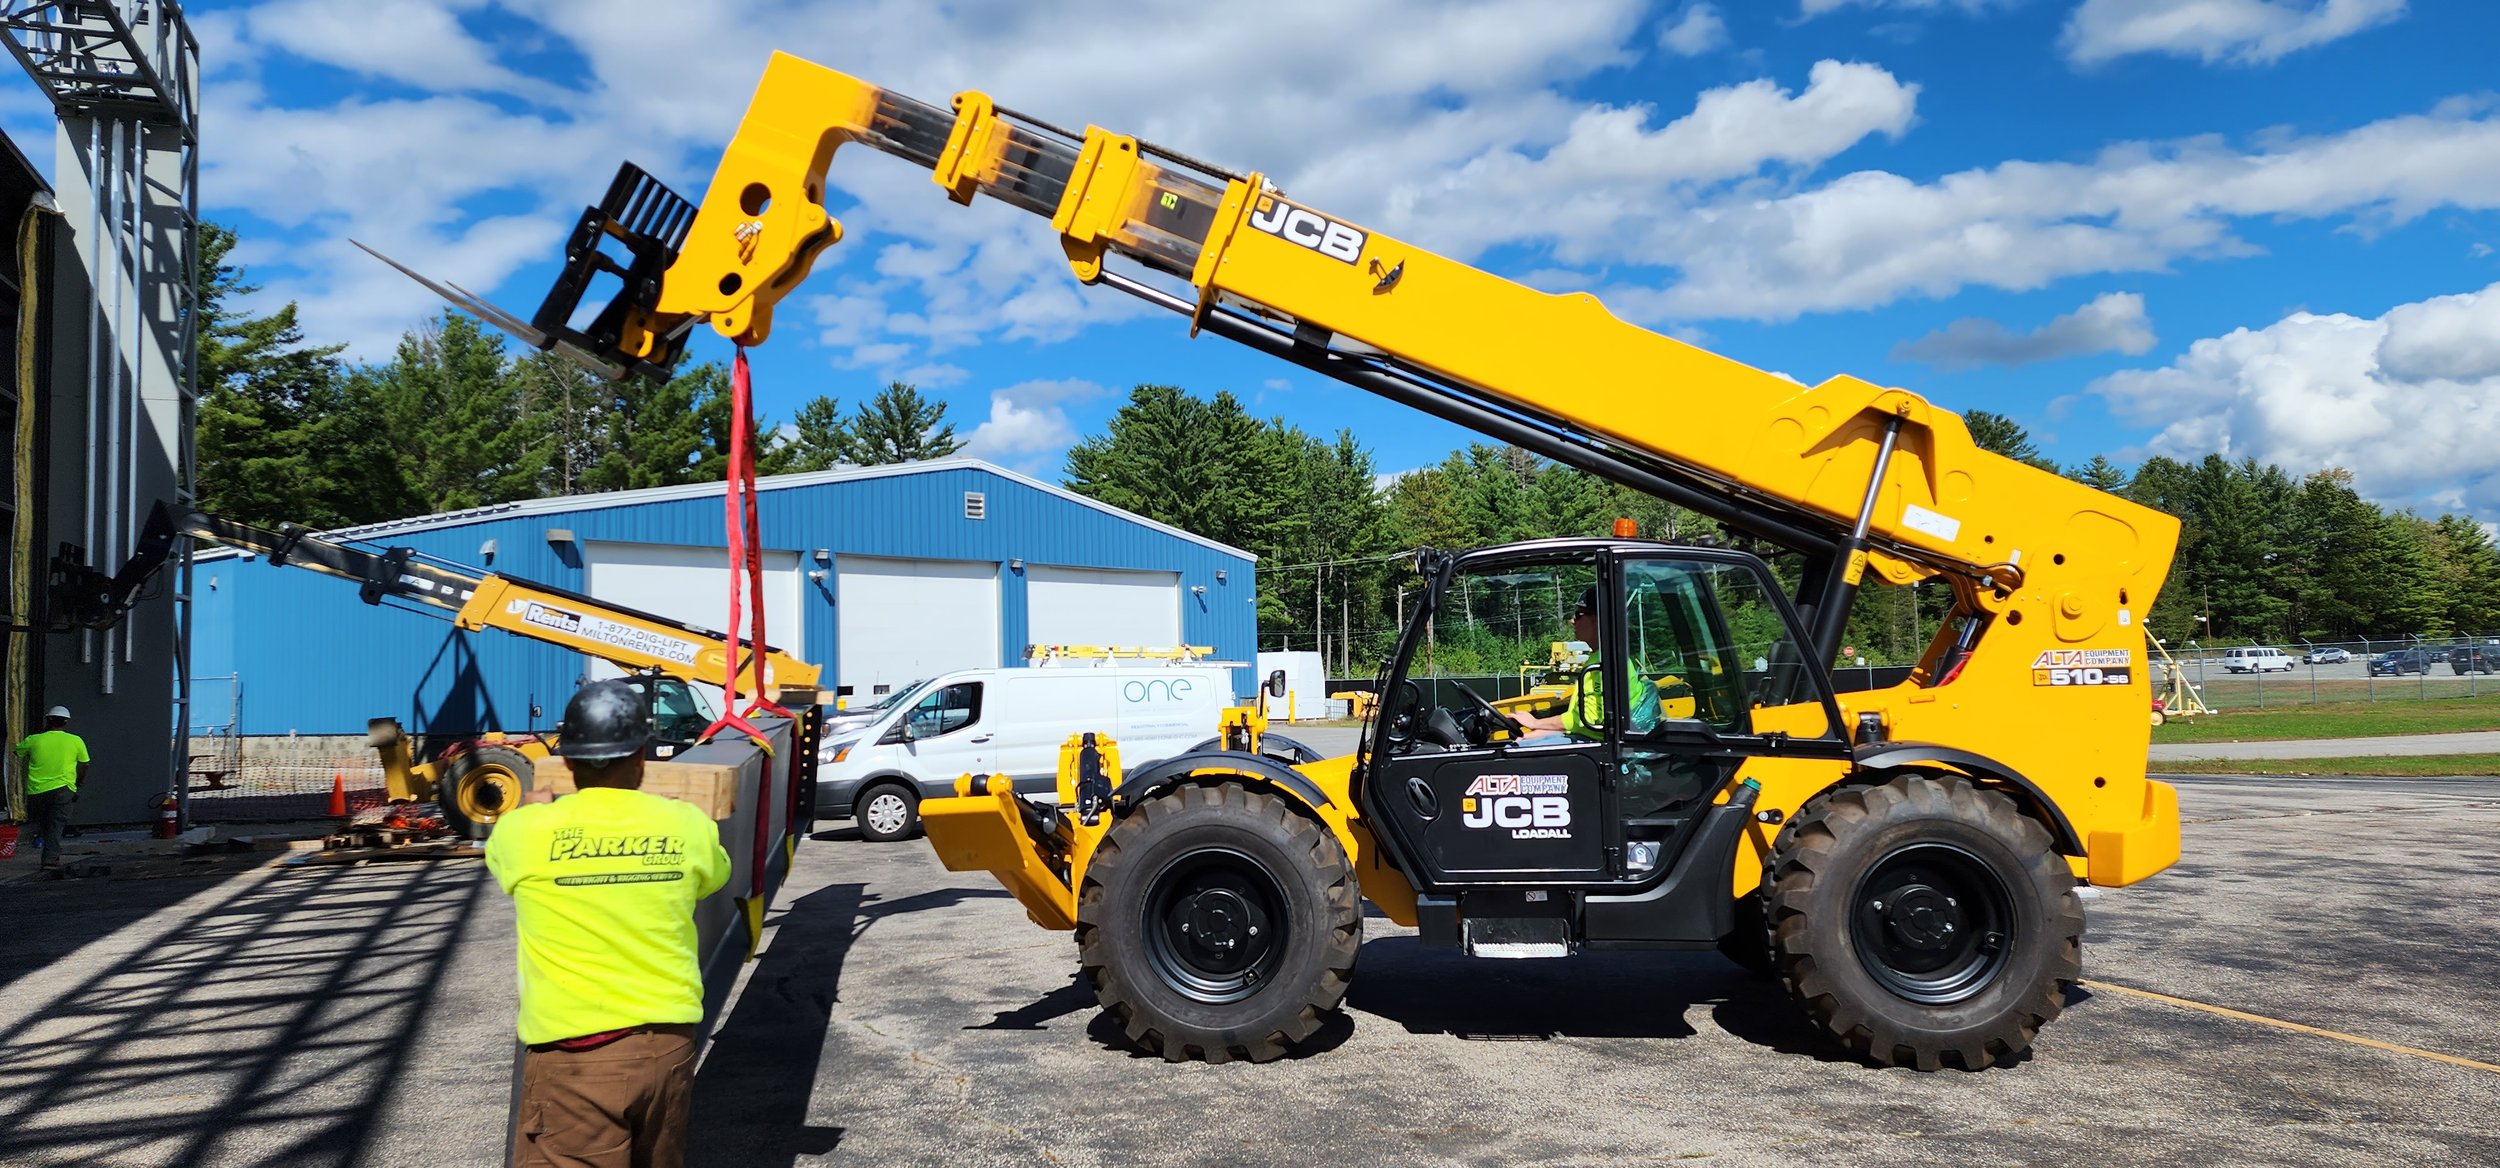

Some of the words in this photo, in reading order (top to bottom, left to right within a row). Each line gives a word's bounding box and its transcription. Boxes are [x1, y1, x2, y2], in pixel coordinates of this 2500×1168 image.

[1252, 202, 1364, 263] JCB
[527, 604, 579, 633] Rents
[598, 621, 689, 651] 1-877-DIG-LIFT
[2034, 650, 2083, 667] ALTA
[2084, 649, 2130, 657] EQUIPMENT
[2084, 657, 2130, 665] COMPANY
[1465, 775, 1520, 795] ALTA
[1520, 775, 1568, 784] EQUIPMENT
[1520, 784, 1568, 794] COMPANY
[1462, 797, 1571, 829] JCB
[554, 827, 584, 841] THE
[1512, 828, 1572, 839] LOADALL
[549, 835, 686, 861] PARKER
[642, 853, 686, 866] GROUP
